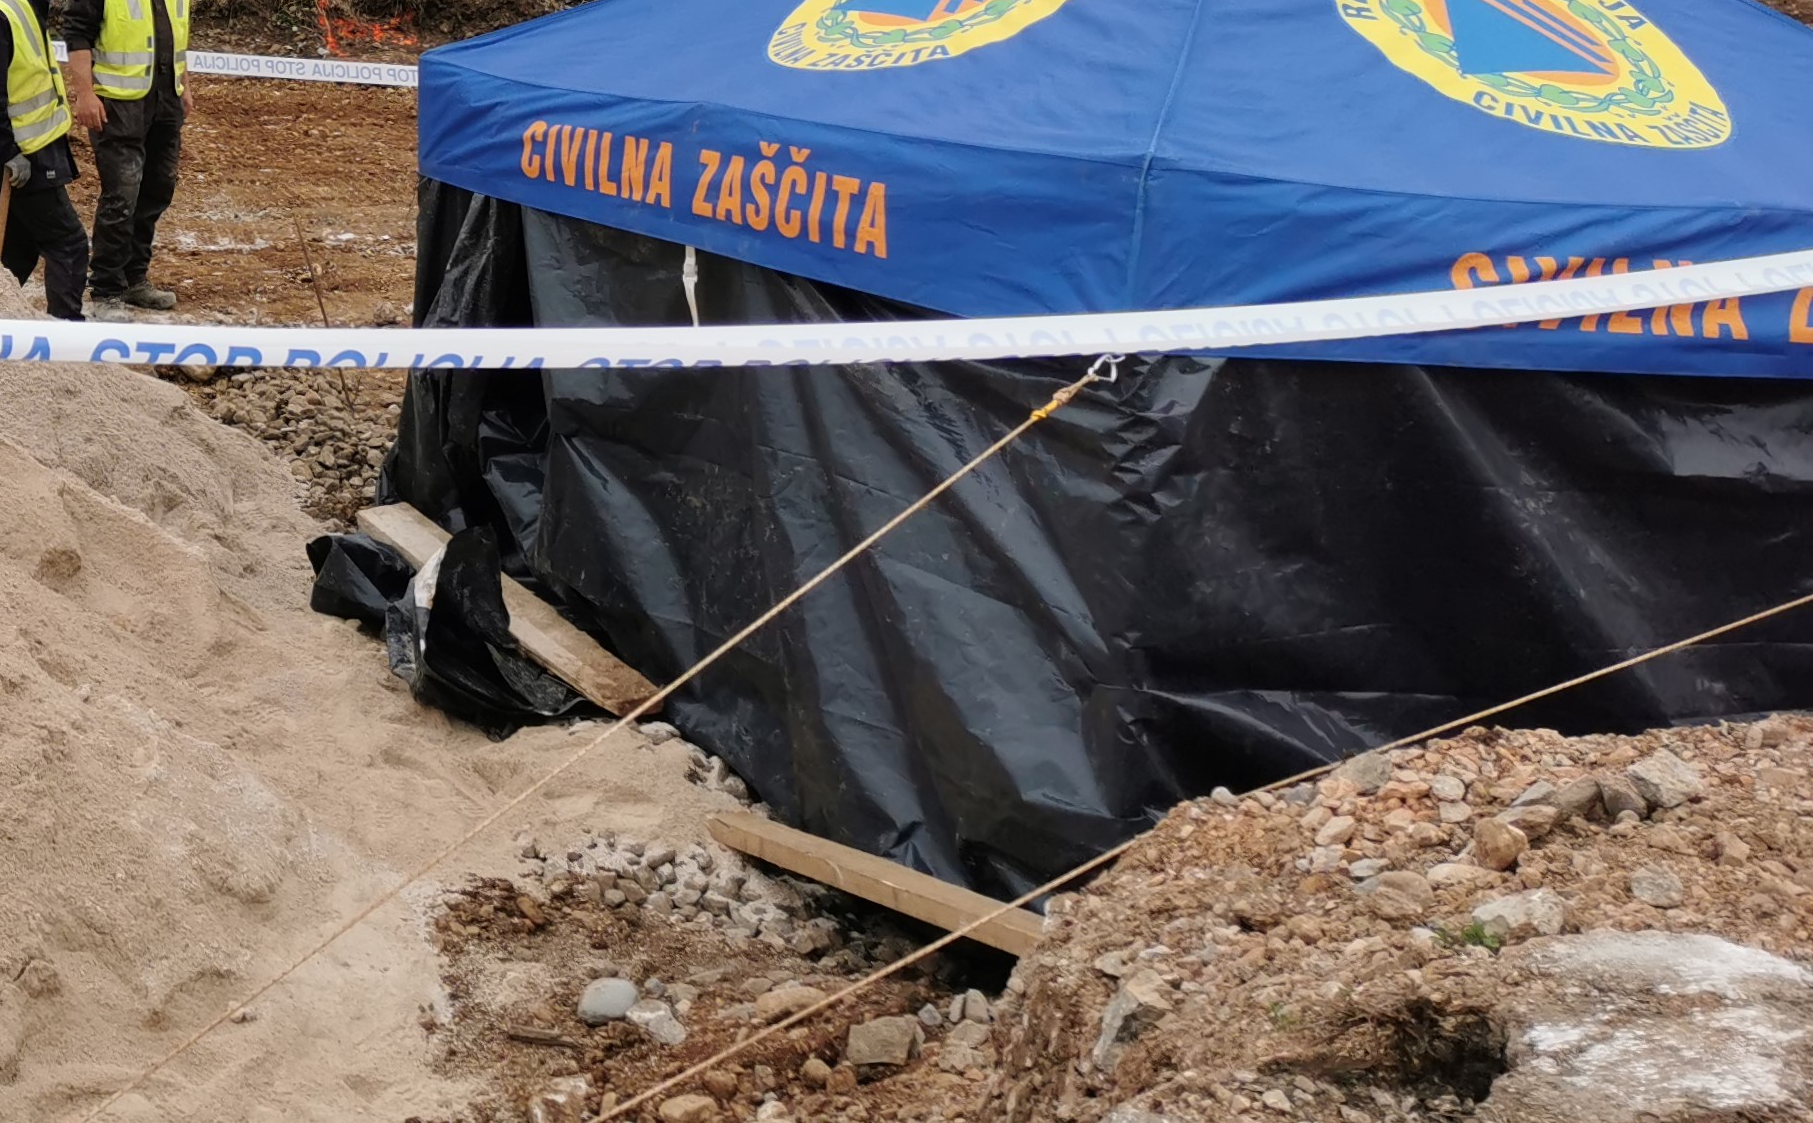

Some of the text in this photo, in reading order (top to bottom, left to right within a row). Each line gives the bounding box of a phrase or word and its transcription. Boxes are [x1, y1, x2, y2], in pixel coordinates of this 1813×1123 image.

[776, 21, 951, 70] CIVILNA ZAŠČITA
[1472, 90, 1728, 147] CIVILNA ZAŠČITA
[520, 120, 888, 259] CIVILNA ZAŠČITA
